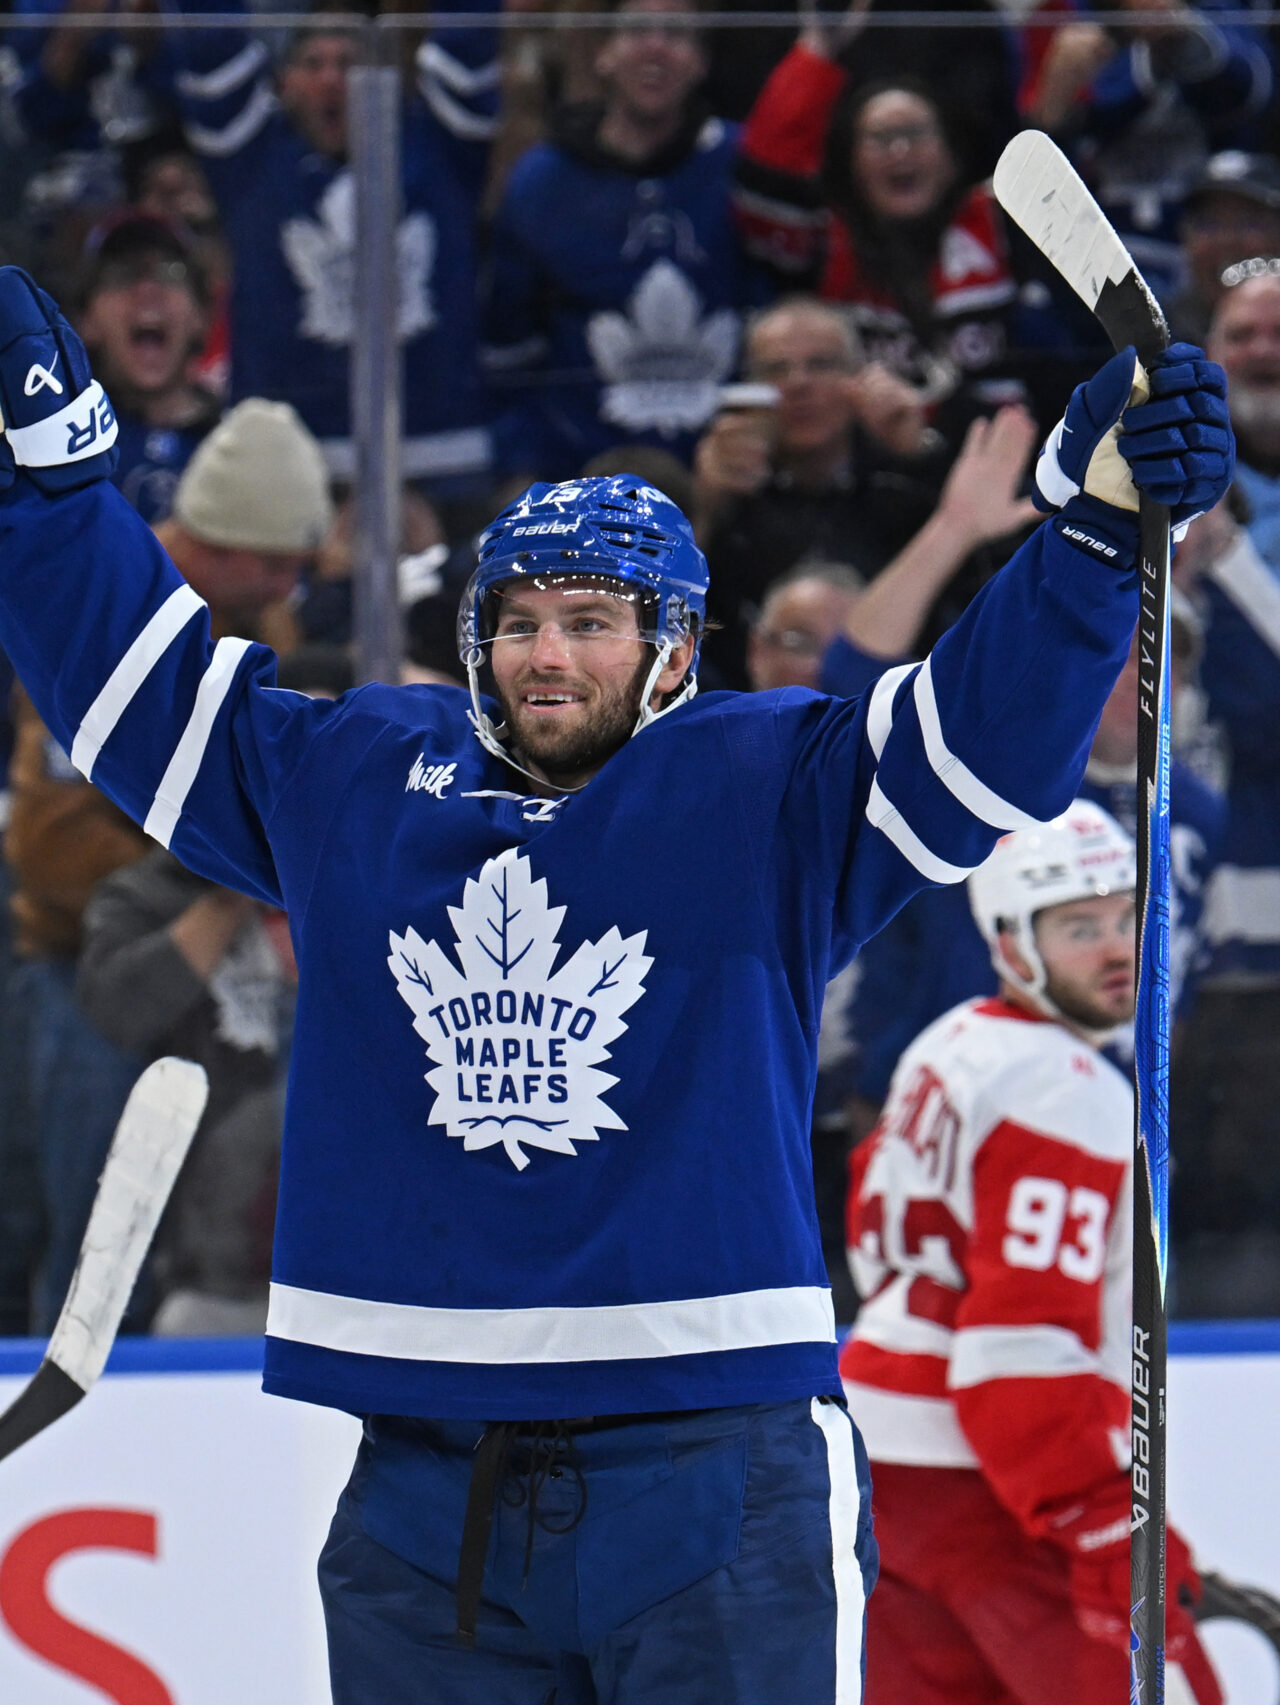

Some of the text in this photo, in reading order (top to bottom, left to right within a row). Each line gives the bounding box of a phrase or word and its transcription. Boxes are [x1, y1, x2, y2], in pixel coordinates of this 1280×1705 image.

[1062, 526, 1118, 557] BAUER
[1140, 557, 1157, 719] FLYLITE
[404, 752, 458, 799] Milk
[428, 990, 596, 1042] TORONTO
[455, 1036, 567, 1067] MAPLE
[457, 1072, 568, 1104] LEAFS
[1002, 1177, 1109, 1284] 93
[1133, 1325, 1150, 1499] BAUER
